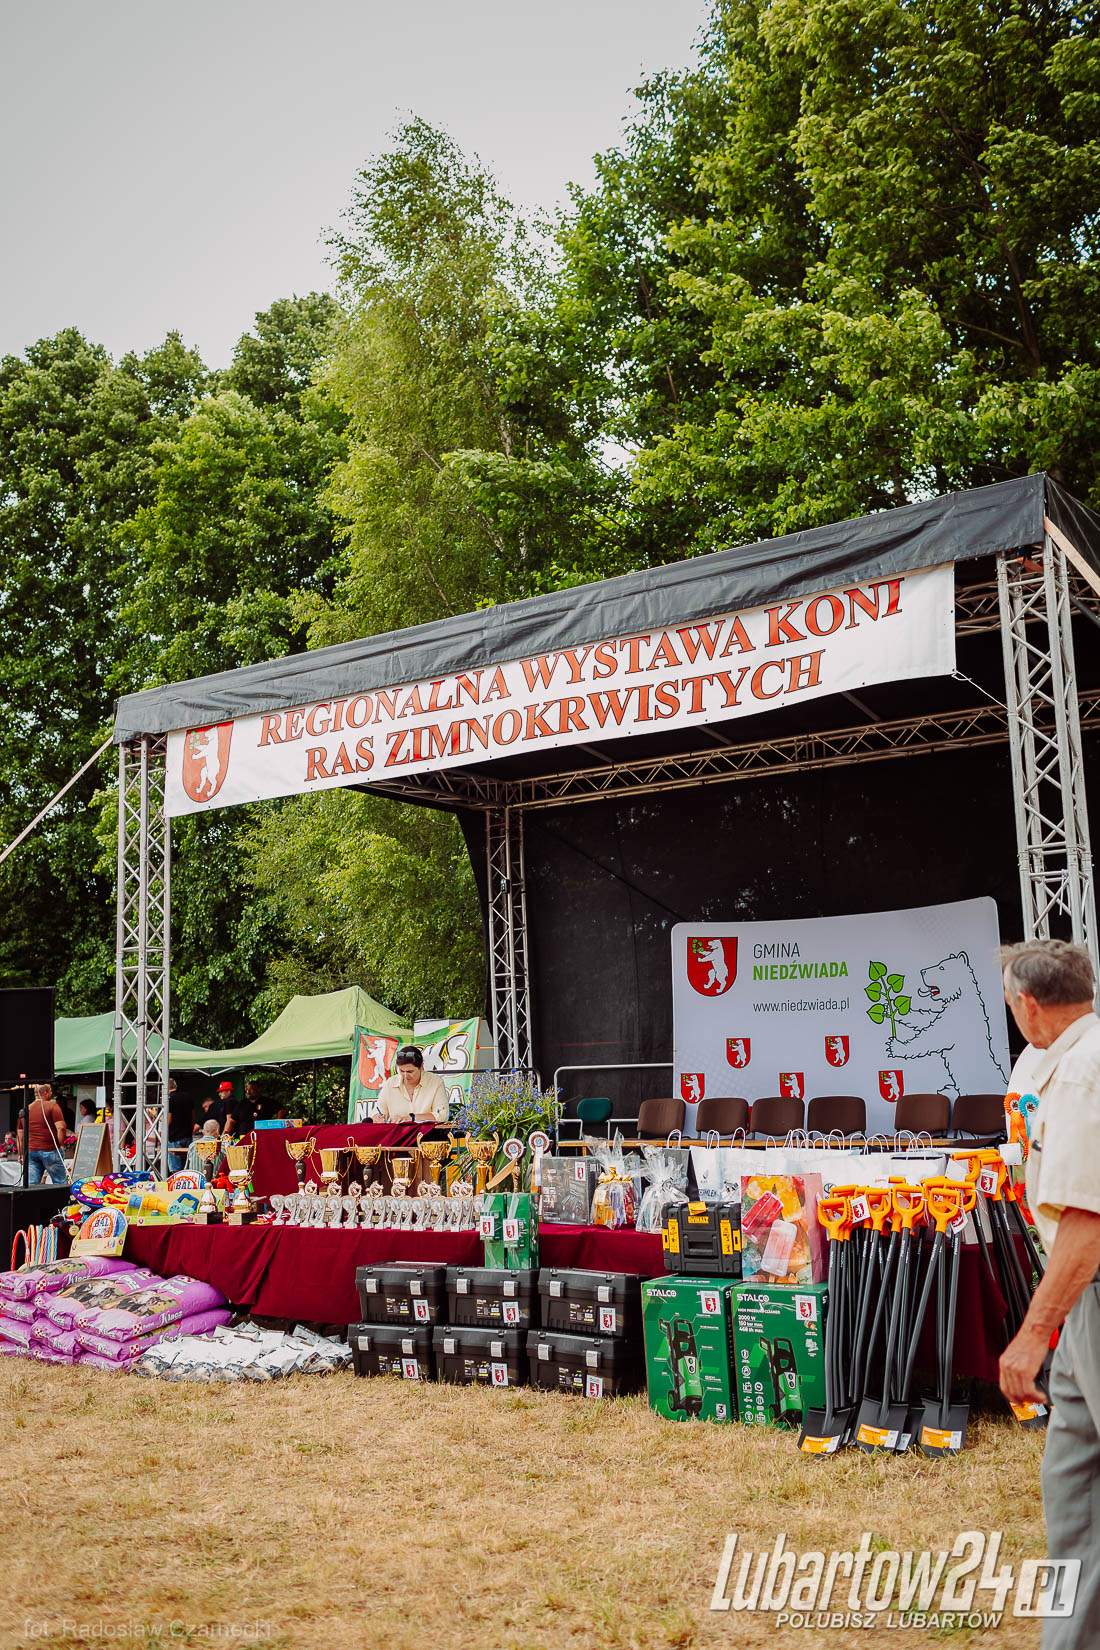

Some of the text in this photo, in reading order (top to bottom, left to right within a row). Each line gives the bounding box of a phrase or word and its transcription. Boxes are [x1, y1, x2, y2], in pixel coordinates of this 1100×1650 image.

[257, 576, 905, 747] REGIONALNA WYSTAWA KONI
[304, 649, 826, 783] RAS ZIMNOKRWISTYCH
[753, 942, 801, 959] GMINA
[752, 960, 849, 981] NIEDŹWIADA
[752, 997, 850, 1014] www.niedzwiada.pl
[646, 1289, 677, 1297] STALCO
[737, 1295, 769, 1303] STALCO
